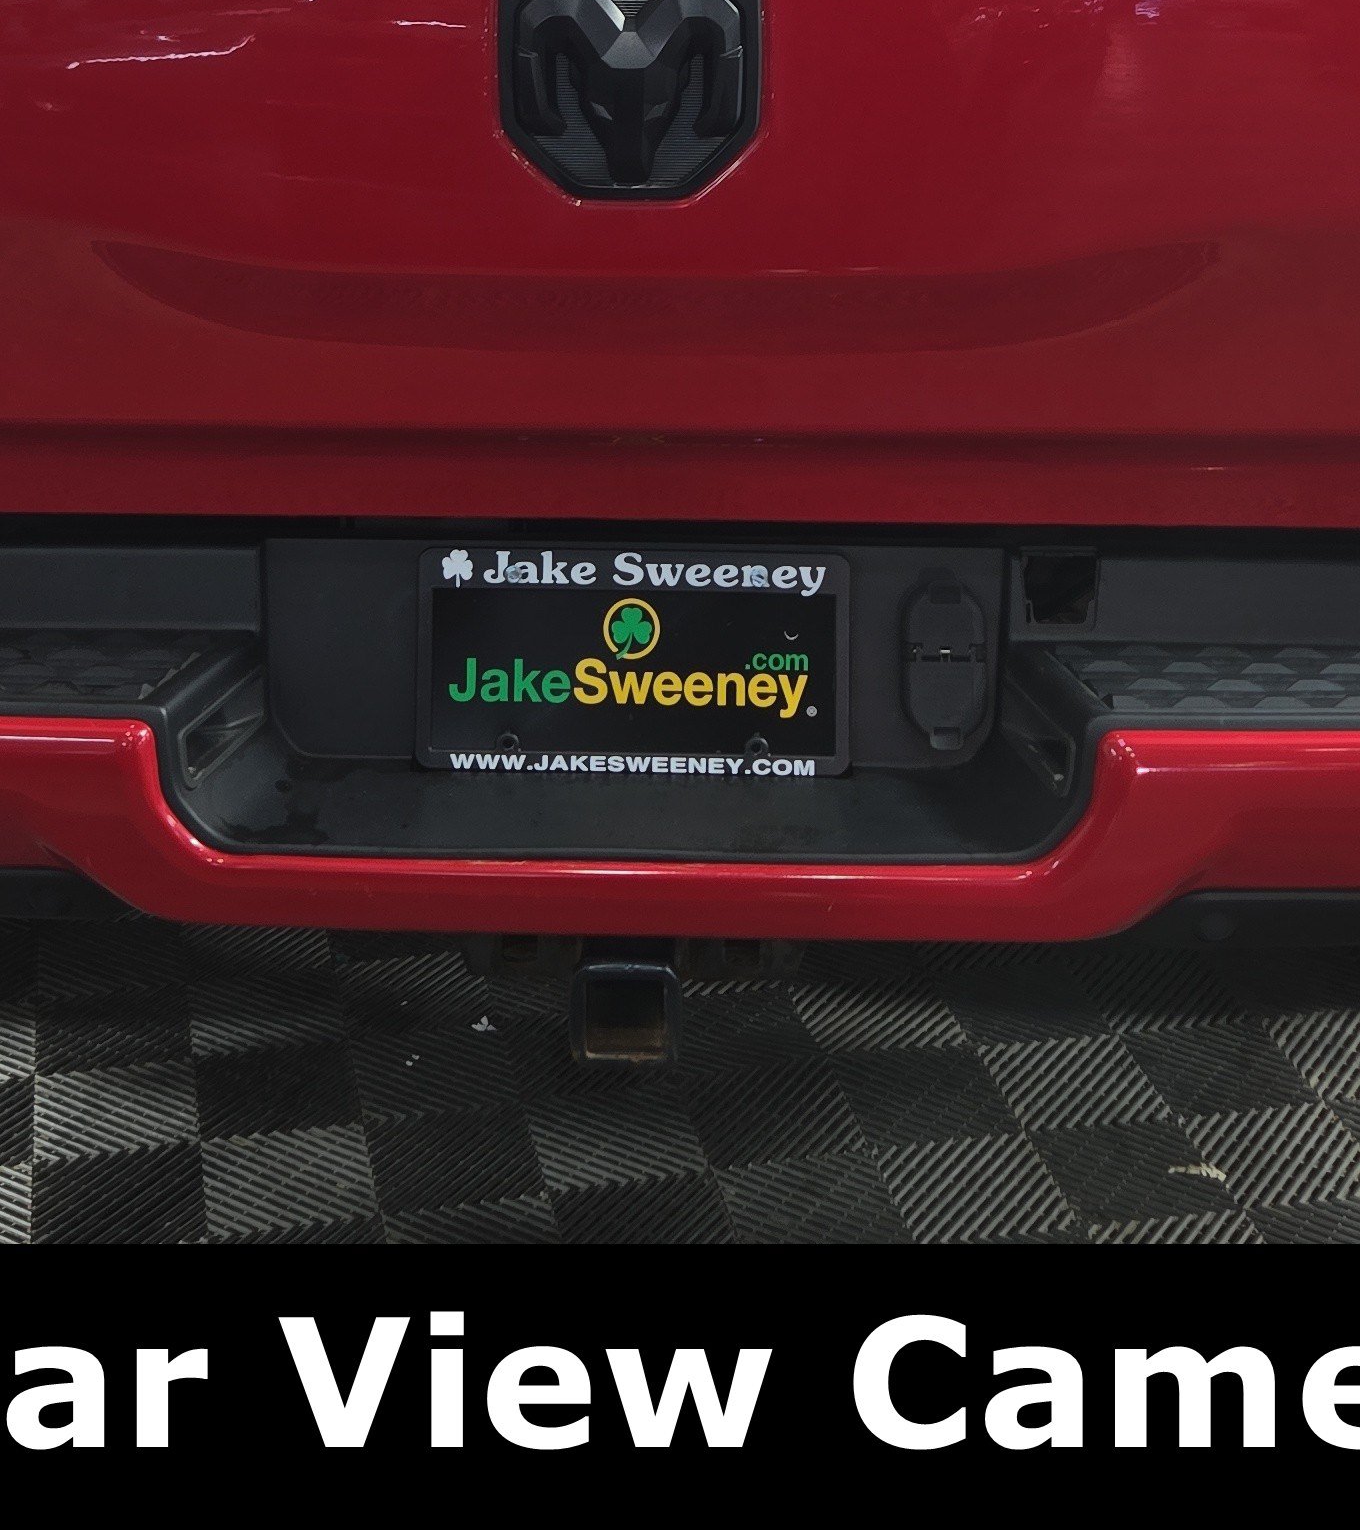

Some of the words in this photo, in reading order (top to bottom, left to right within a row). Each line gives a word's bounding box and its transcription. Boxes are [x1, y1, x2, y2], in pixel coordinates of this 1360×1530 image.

[483, 550, 597, 586] Jake
[612, 551, 827, 597] Sweeney
[449, 753, 816, 777] WWW.JAKESWEENEY.COM
